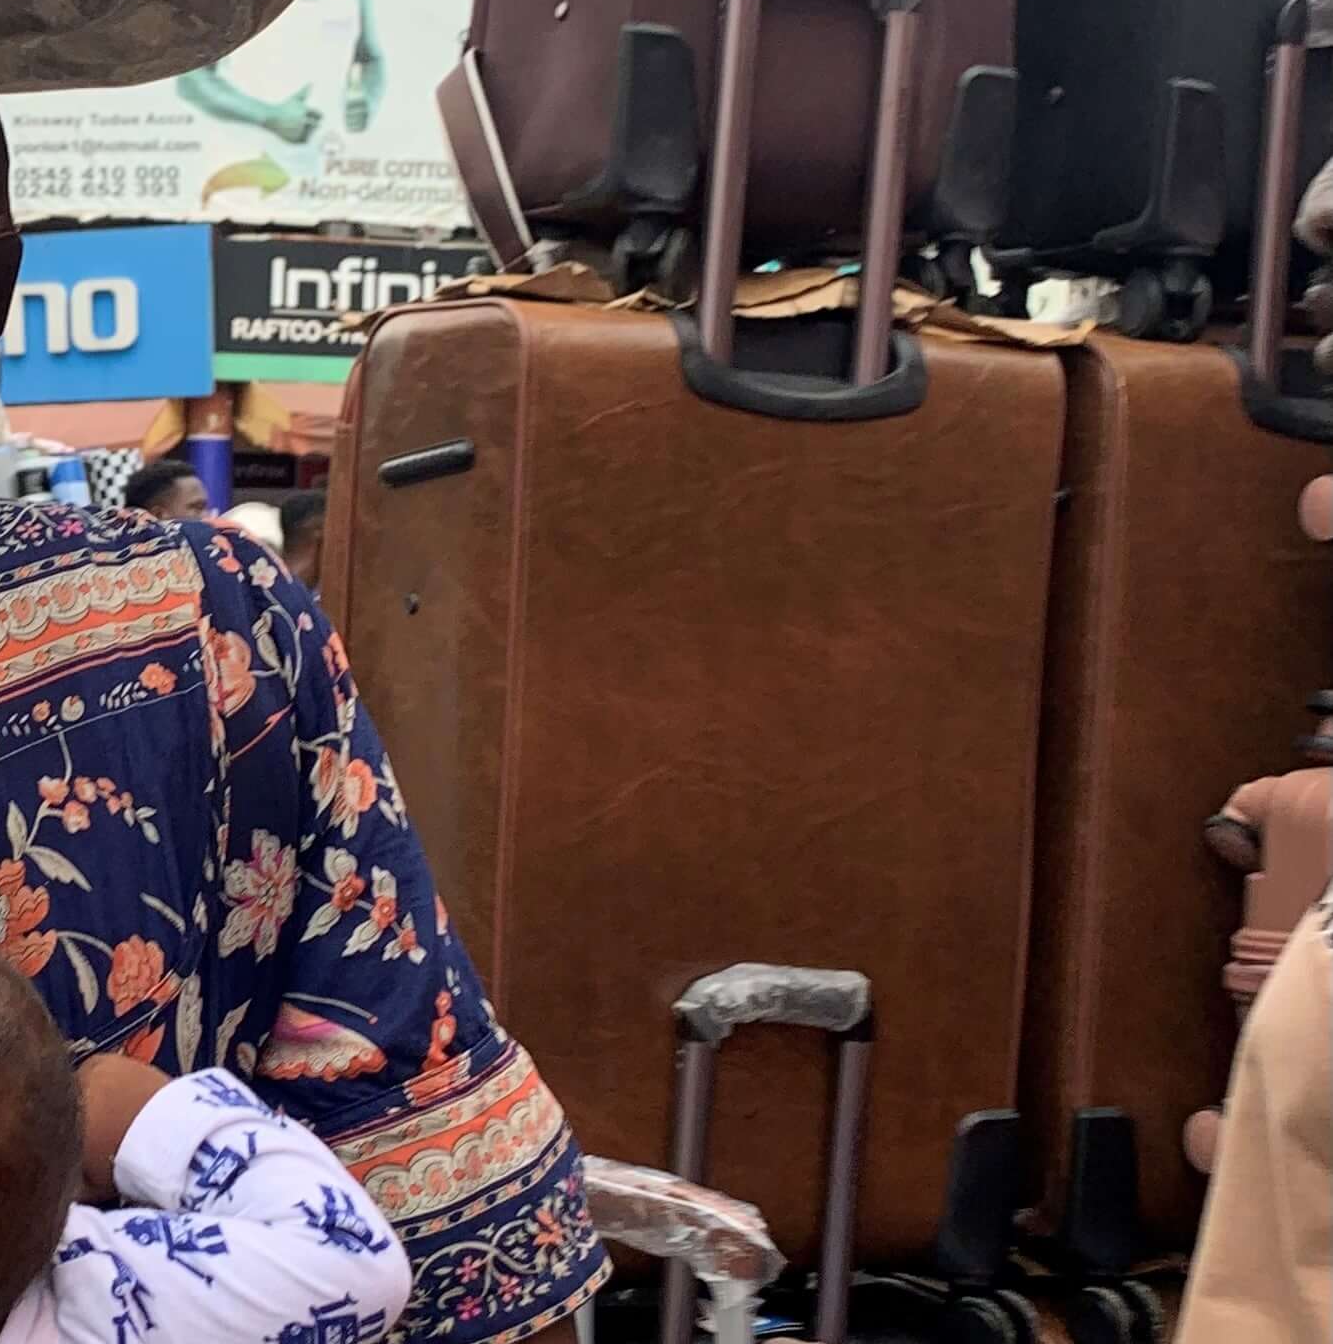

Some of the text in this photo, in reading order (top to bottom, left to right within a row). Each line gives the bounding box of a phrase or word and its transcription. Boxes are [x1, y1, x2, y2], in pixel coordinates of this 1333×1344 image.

[15, 165, 72, 181] 0545
[325, 159, 380, 176] PURE
[15, 181, 71, 198] 0246
[299, 178, 464, 203] Non-deforma
